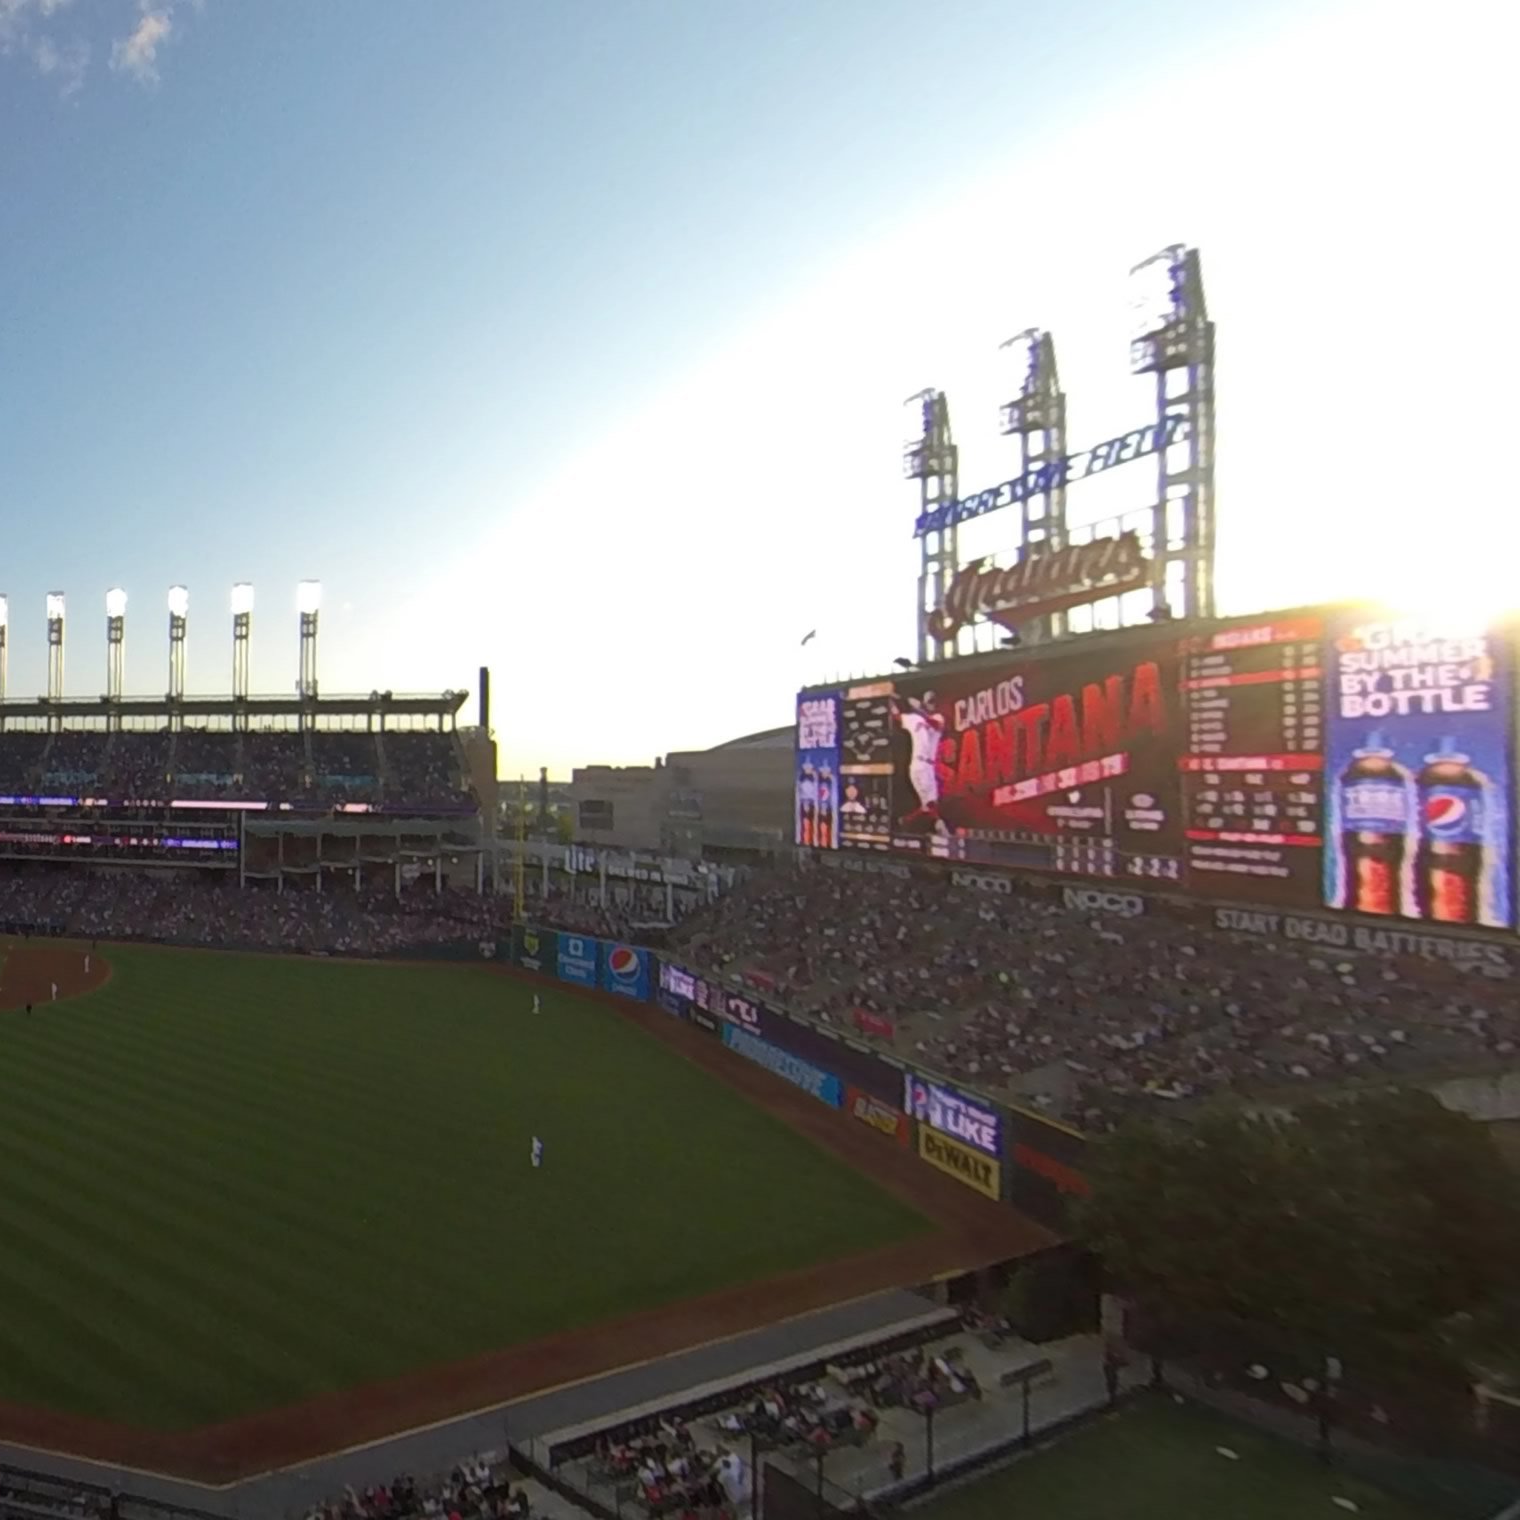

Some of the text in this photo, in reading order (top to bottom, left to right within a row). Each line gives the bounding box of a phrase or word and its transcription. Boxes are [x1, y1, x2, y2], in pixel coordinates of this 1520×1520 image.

[1340, 637, 1486, 673] SUMMER
[1341, 664, 1462, 694] BY THE
[954, 675, 1023, 732] CARLOS
[1341, 684, 1492, 718] BOTTLE
[939, 661, 1163, 796] SANTANA
[1062, 887, 1144, 918] NOCO
[1215, 908, 1508, 967] START DEAD BATTERIES
